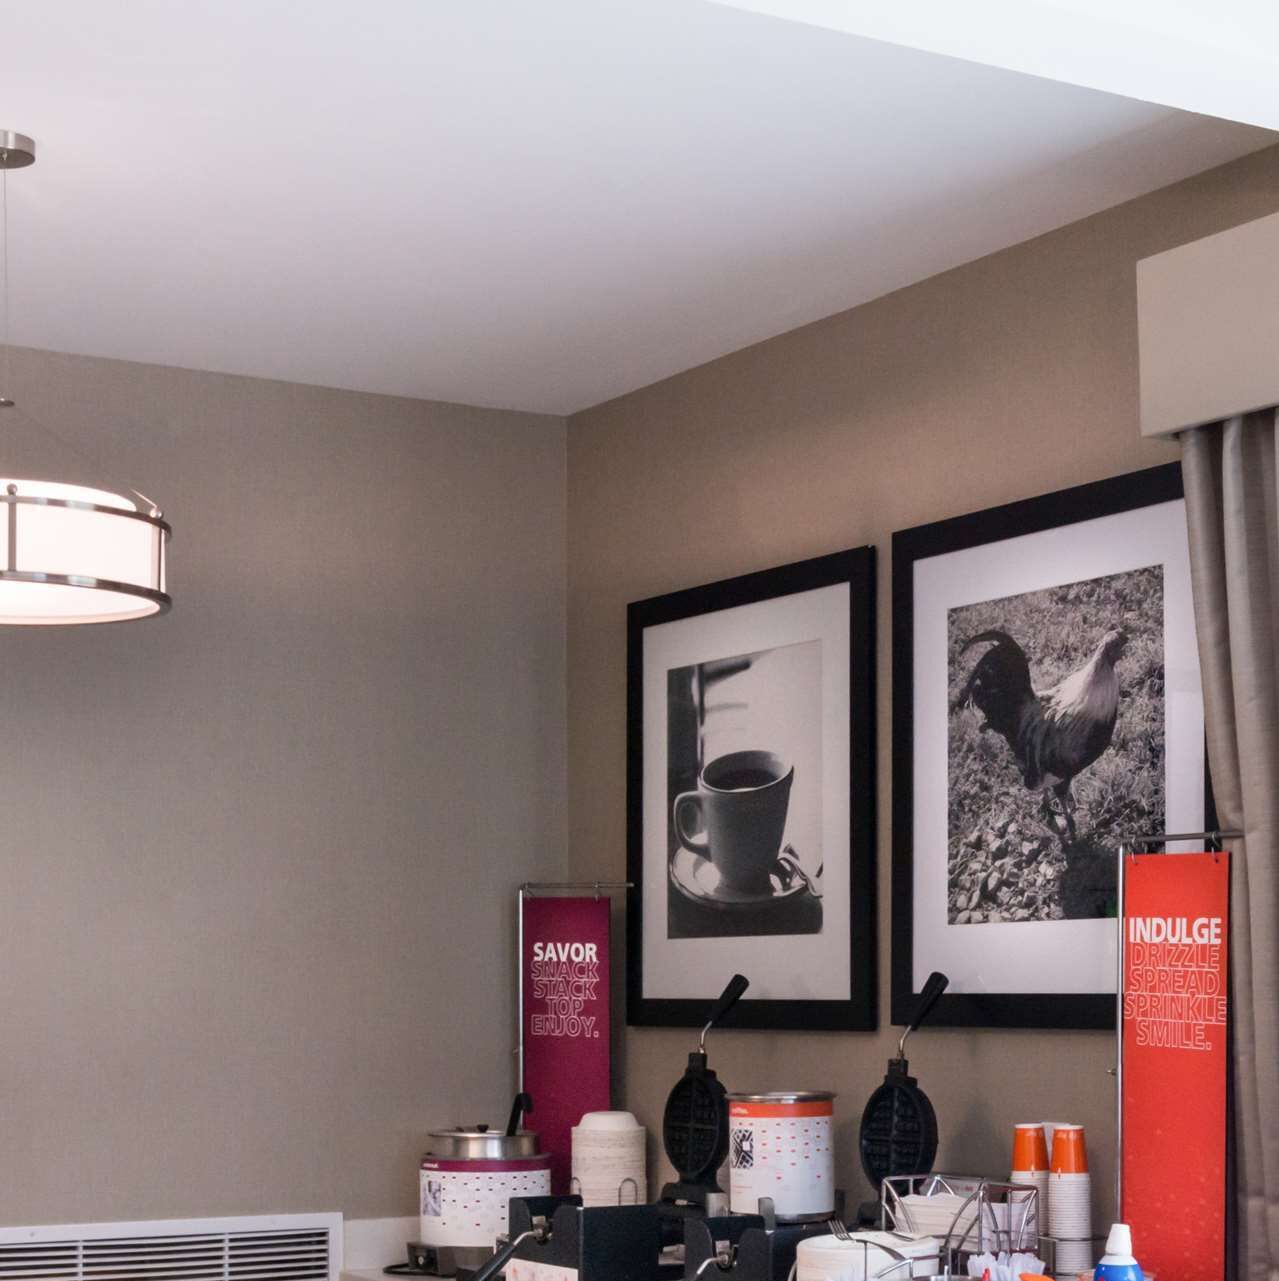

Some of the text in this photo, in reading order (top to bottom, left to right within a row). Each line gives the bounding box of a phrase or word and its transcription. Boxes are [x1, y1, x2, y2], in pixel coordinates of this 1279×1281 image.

[1129, 917, 1222, 944] INDULGE
[533, 942, 598, 962] SAVOR
[1130, 942, 1220, 971] DRIZZLE
[531, 960, 600, 981] SNACK
[1129, 967, 1220, 997] SPREAD
[533, 979, 597, 1000] STACK
[545, 996, 584, 1018] TOP
[1124, 992, 1227, 1025] SPRINKLE
[531, 1014, 600, 1038] ENJOY.
[1135, 1018, 1213, 1051] SMILE.
